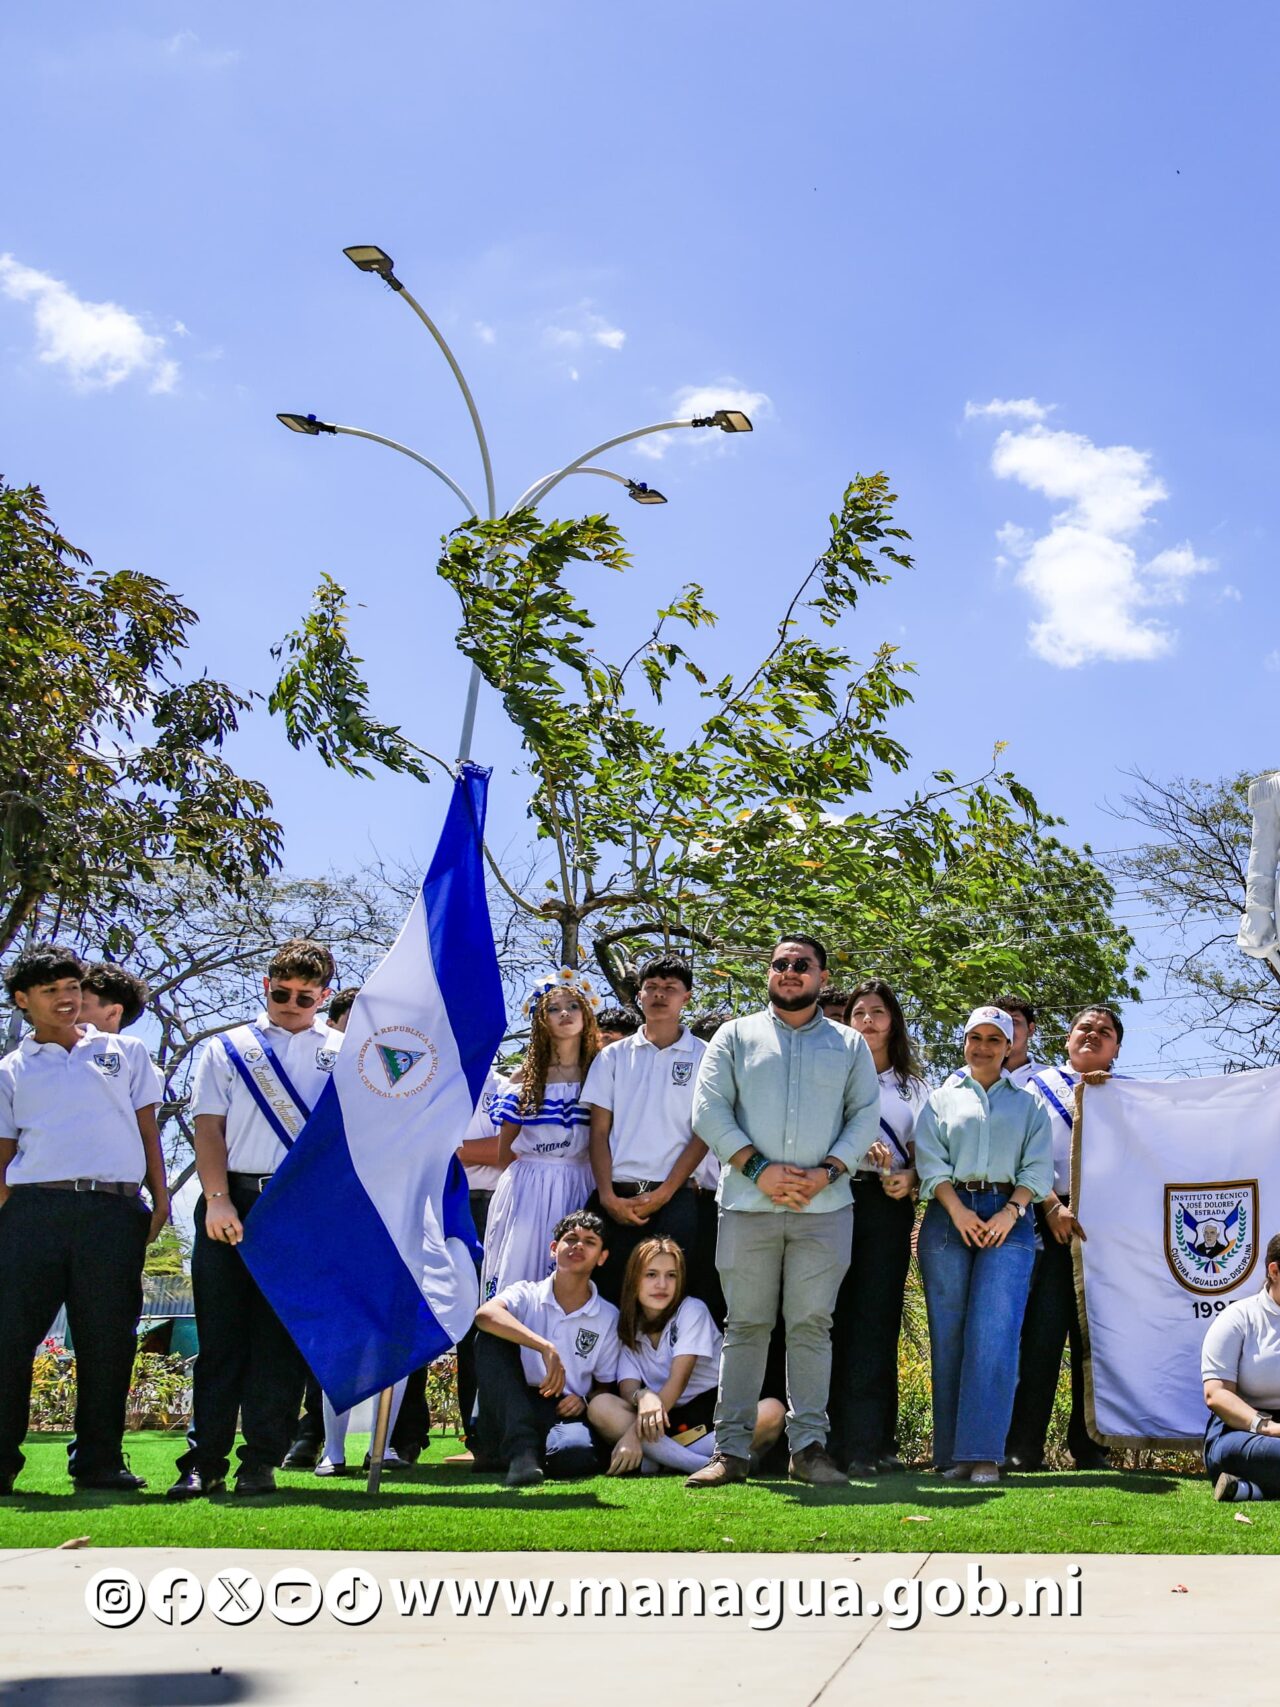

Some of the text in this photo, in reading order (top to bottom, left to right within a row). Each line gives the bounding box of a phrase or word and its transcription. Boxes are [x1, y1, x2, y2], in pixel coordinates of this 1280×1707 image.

[380, 1025, 429, 1044] REPUBLICA
[403, 1056, 438, 1098] NICARAGUA
[1171, 1191, 1249, 1201] INSTITUTO TÉCNICO
[1186, 1200, 1235, 1209] JOSÉ DOLORES
[1171, 1247, 1190, 1279] CULTURA
[1230, 1243, 1252, 1279] DISCIPLINA
[1192, 1300, 1237, 1319] 199
